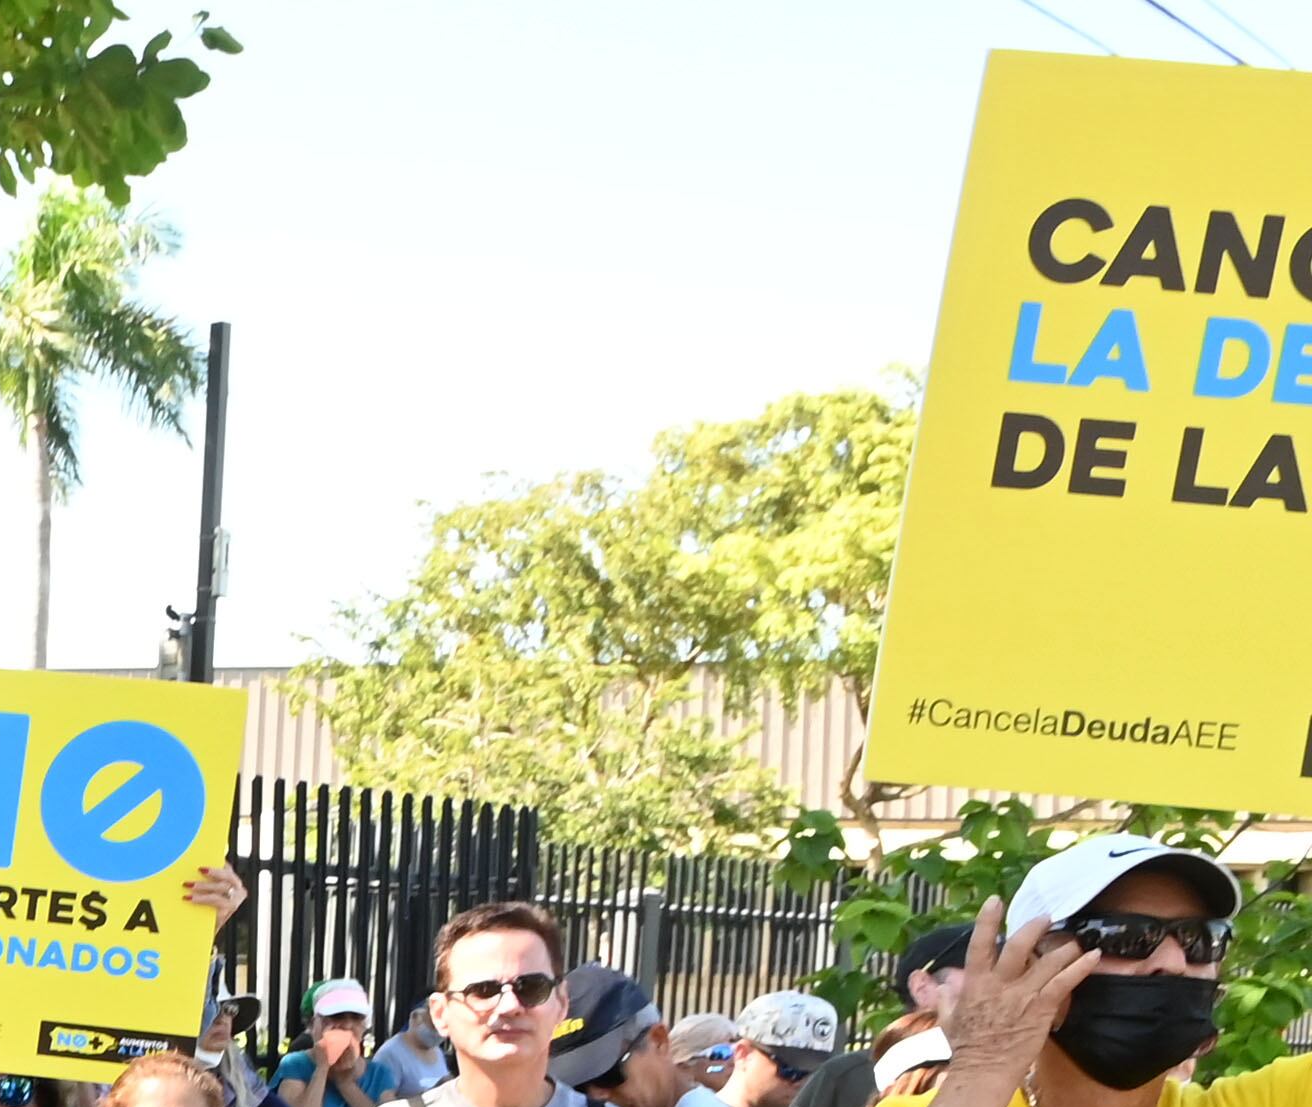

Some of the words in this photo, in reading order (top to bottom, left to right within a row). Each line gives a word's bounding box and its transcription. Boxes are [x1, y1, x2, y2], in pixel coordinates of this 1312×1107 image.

[1028, 197, 1312, 303] CAN
[1007, 301, 1150, 391] LA
[990, 411, 1137, 498] DE
[1171, 425, 1310, 513] LA
[907, 698, 1239, 752] #CancelaDeudaAEE
[124, 896, 161, 936] A
[130, 1047, 144, 1056] LA
